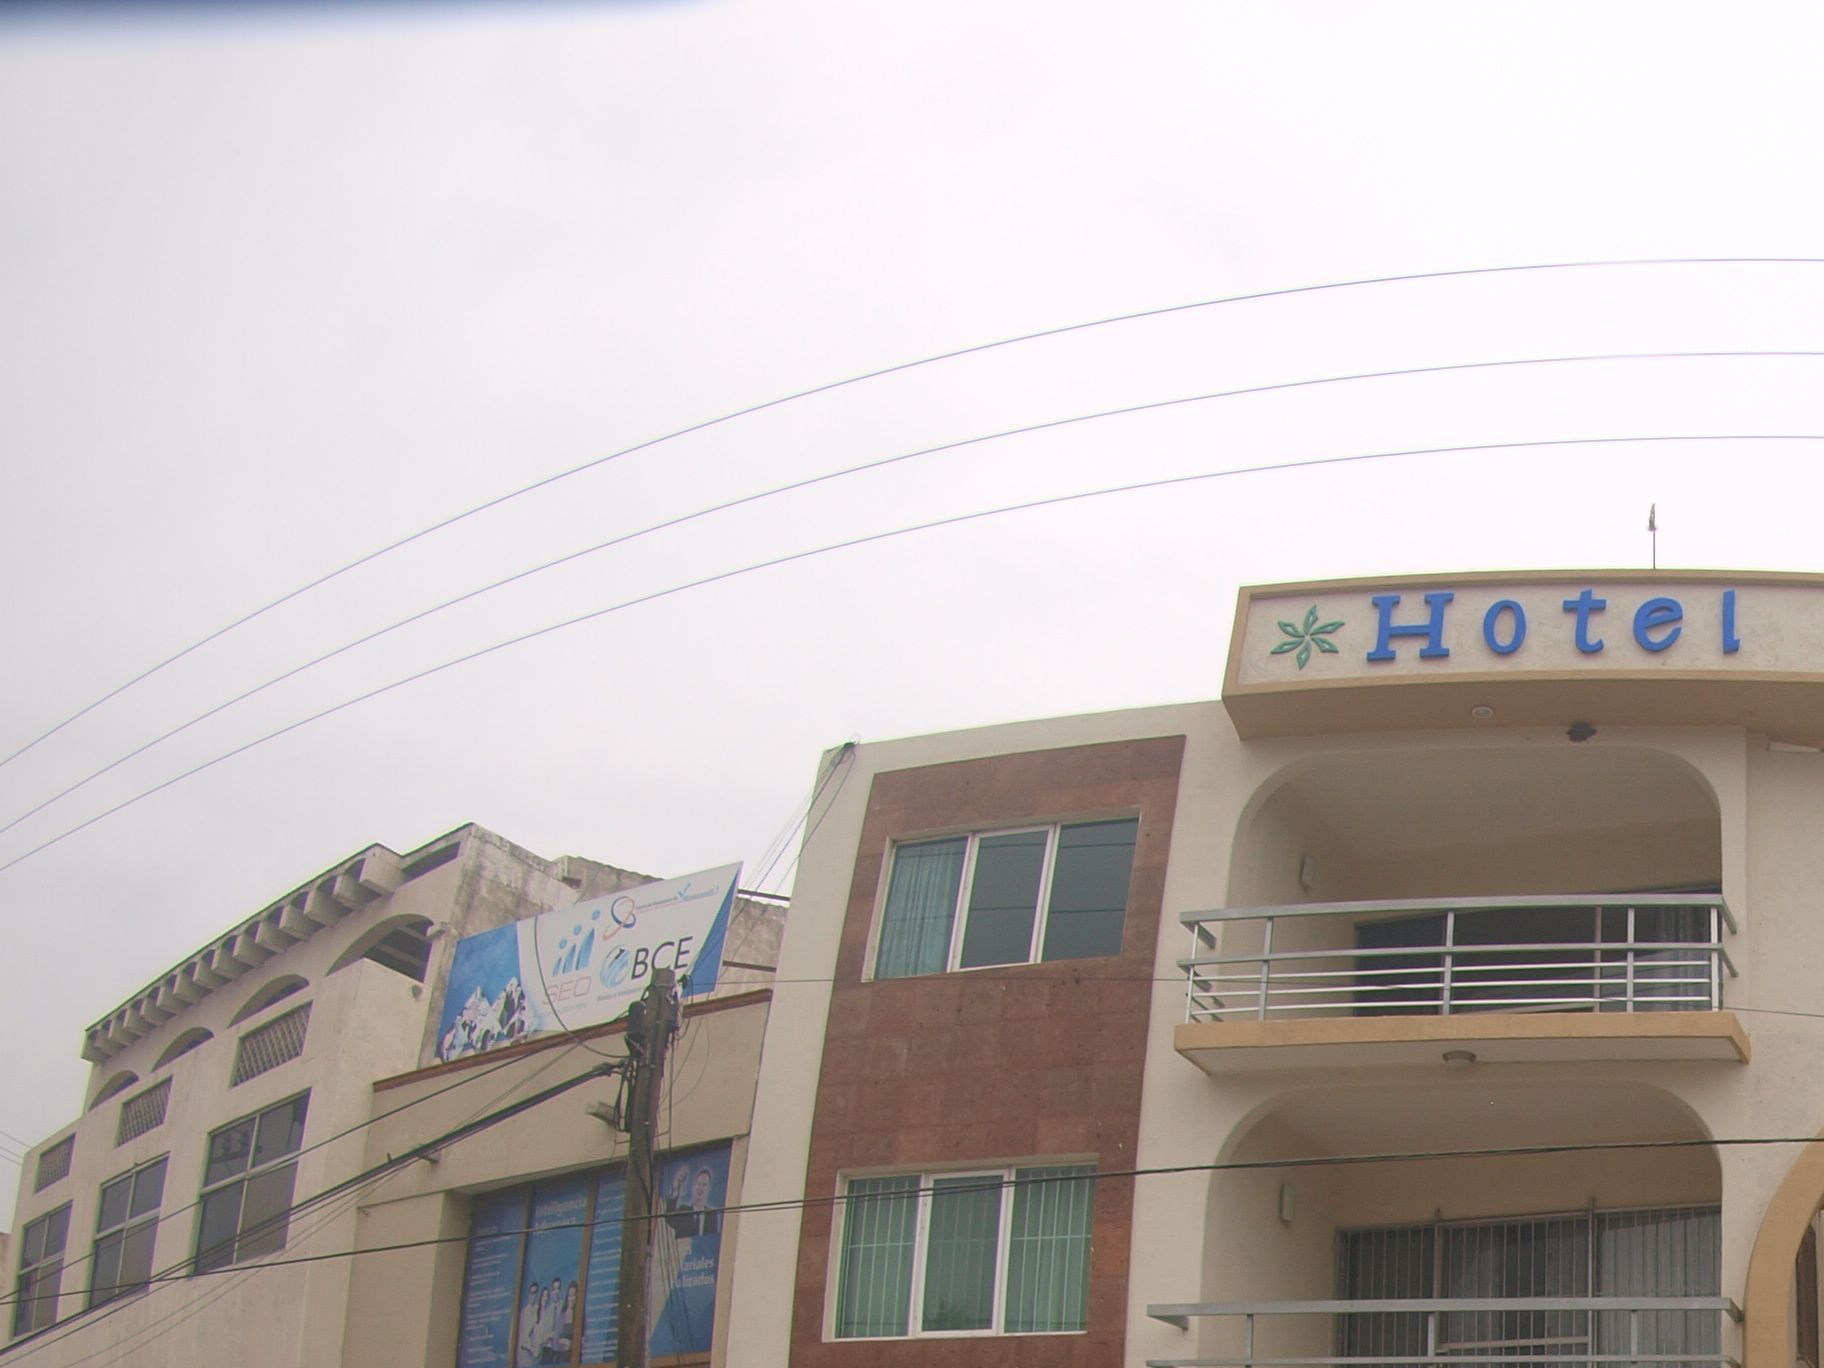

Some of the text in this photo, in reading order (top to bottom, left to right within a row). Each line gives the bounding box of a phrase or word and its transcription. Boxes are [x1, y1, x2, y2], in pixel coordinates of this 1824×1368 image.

[1366, 588, 1741, 662] Hotel
[631, 936, 693, 980] BCE
[542, 976, 592, 1004] SEO
